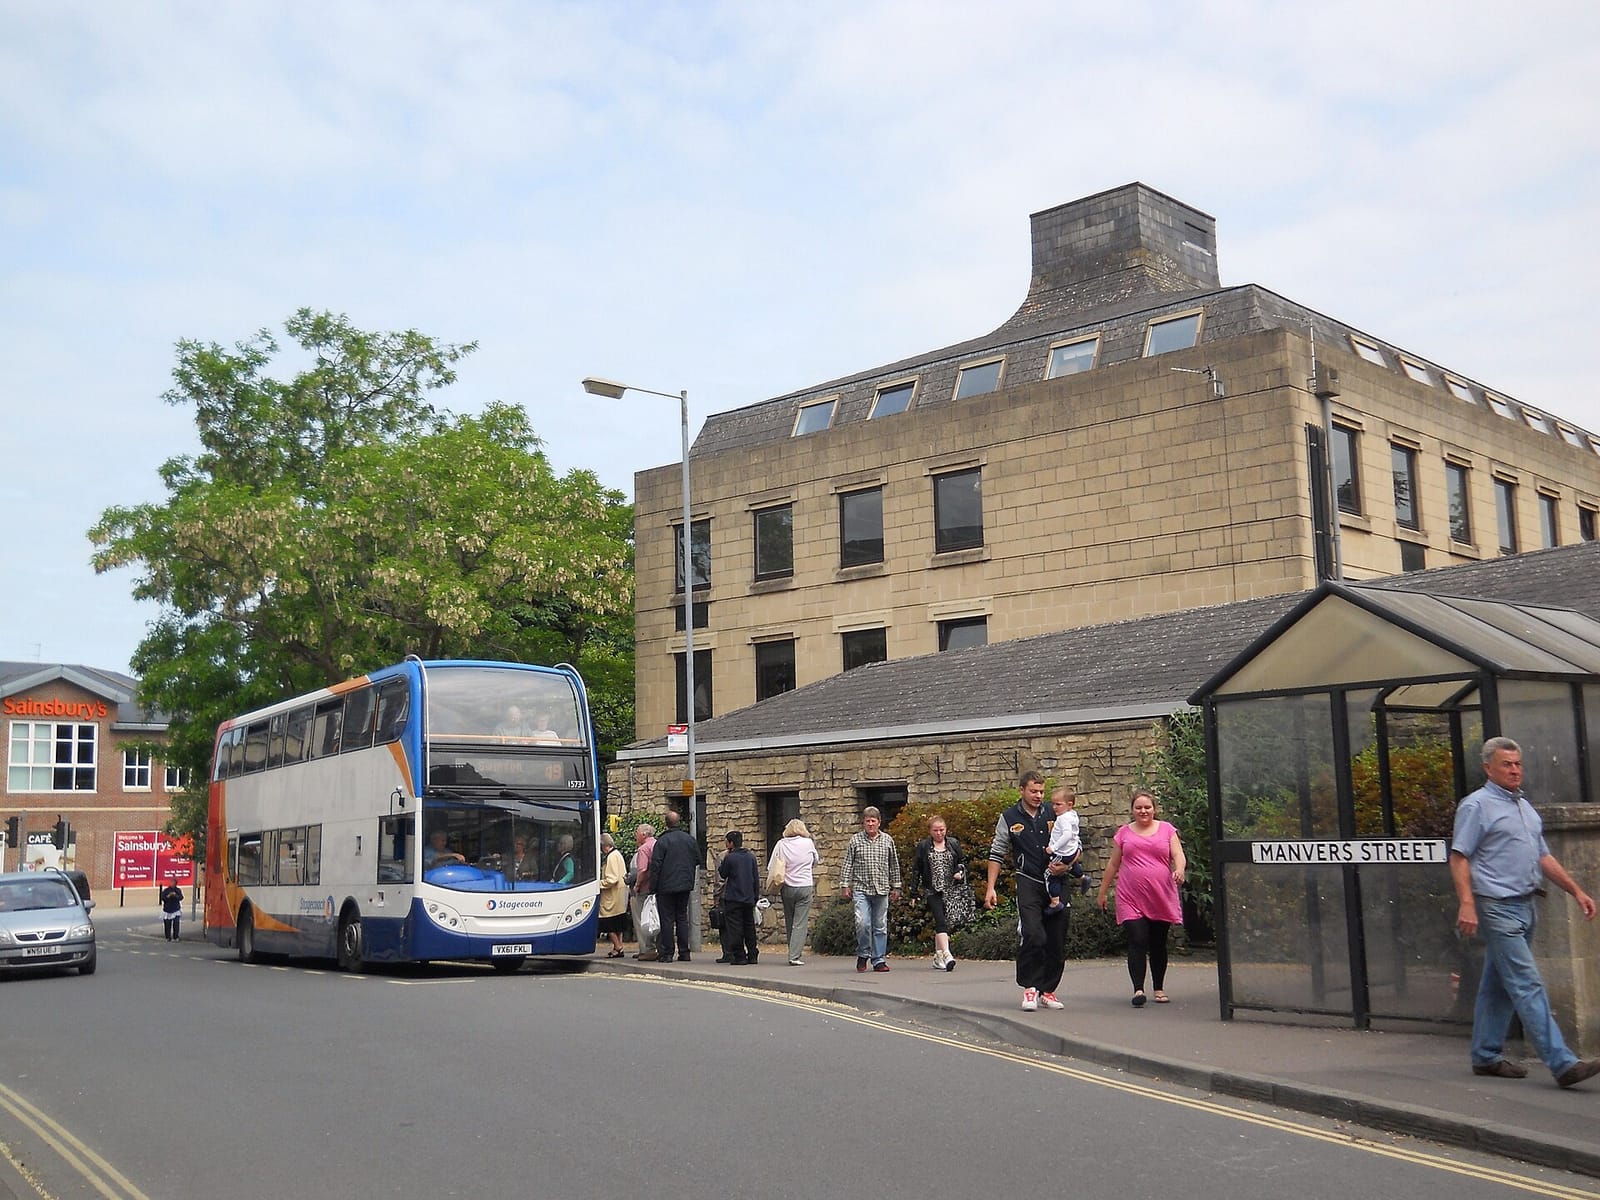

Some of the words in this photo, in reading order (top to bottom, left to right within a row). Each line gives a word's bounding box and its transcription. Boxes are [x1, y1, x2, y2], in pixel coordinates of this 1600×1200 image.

[3, 696, 108, 720] Sainsbury's
[567, 780, 586, 788] 15737
[1260, 843, 1353, 862] MANVERS
[1361, 842, 1437, 861] STREET
[498, 900, 543, 910] Stagecoach
